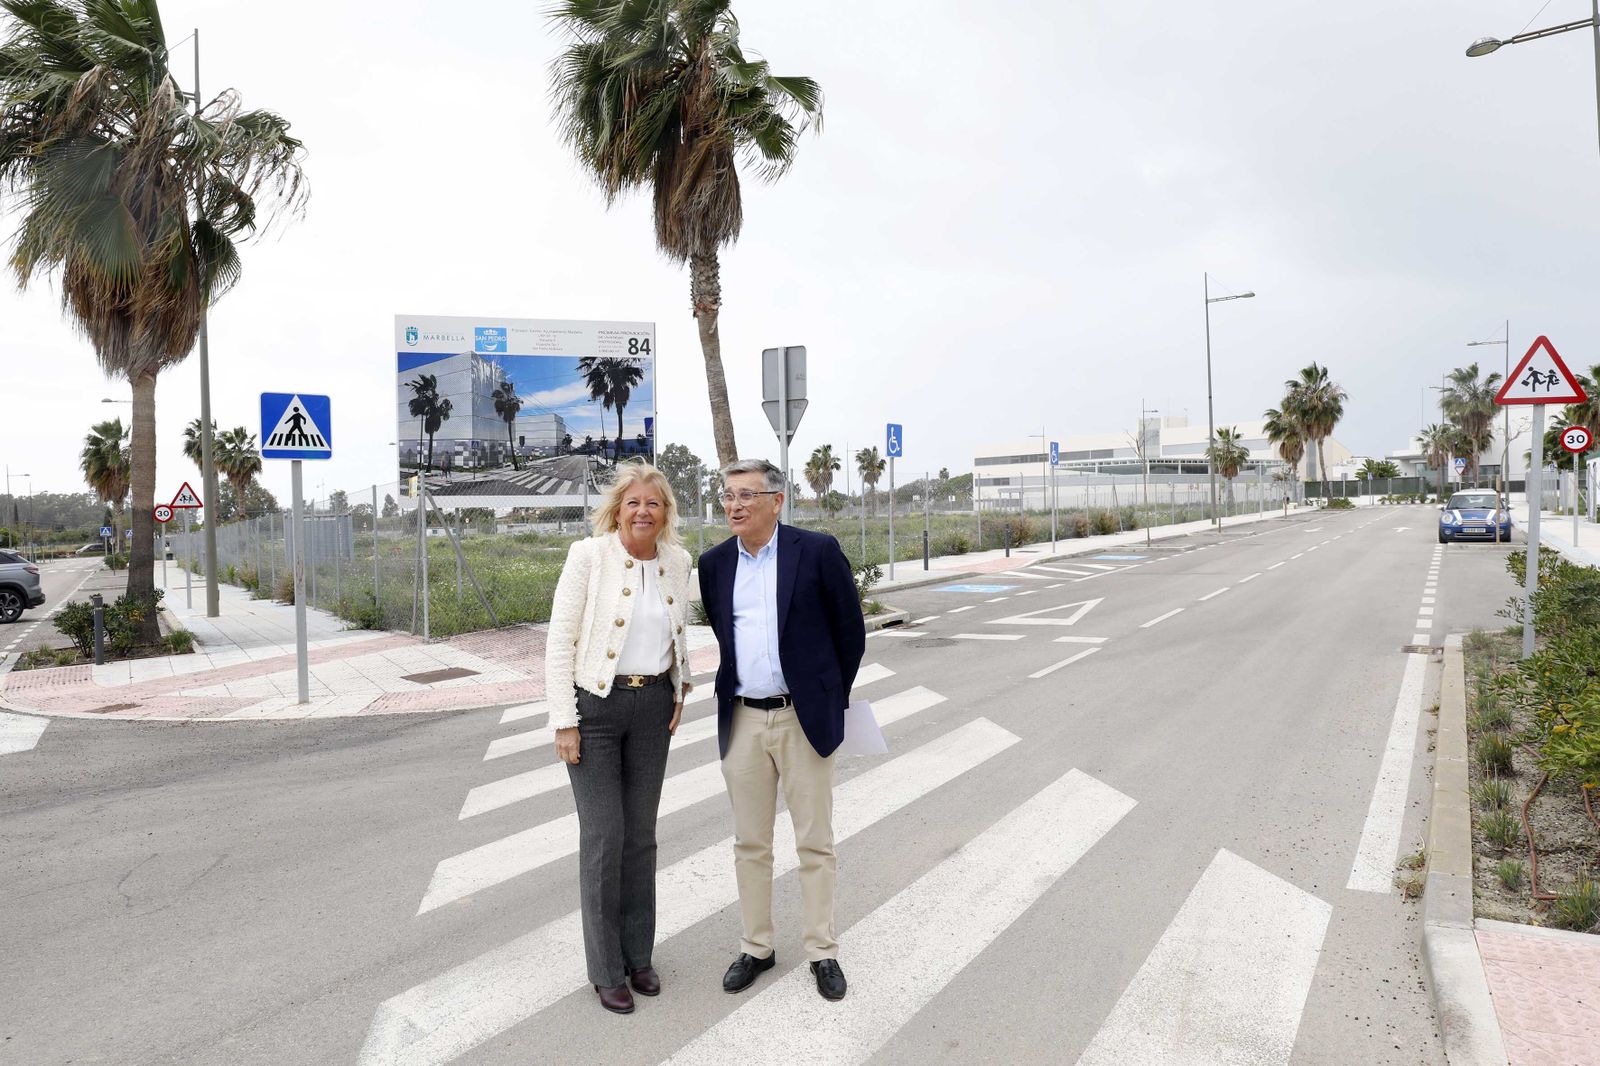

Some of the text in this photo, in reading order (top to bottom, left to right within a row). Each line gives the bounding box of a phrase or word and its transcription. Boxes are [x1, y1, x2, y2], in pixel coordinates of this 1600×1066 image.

[423, 334, 466, 342] MARBELLA
[628, 338, 651, 355] 84
[1567, 435, 1585, 444] 30
